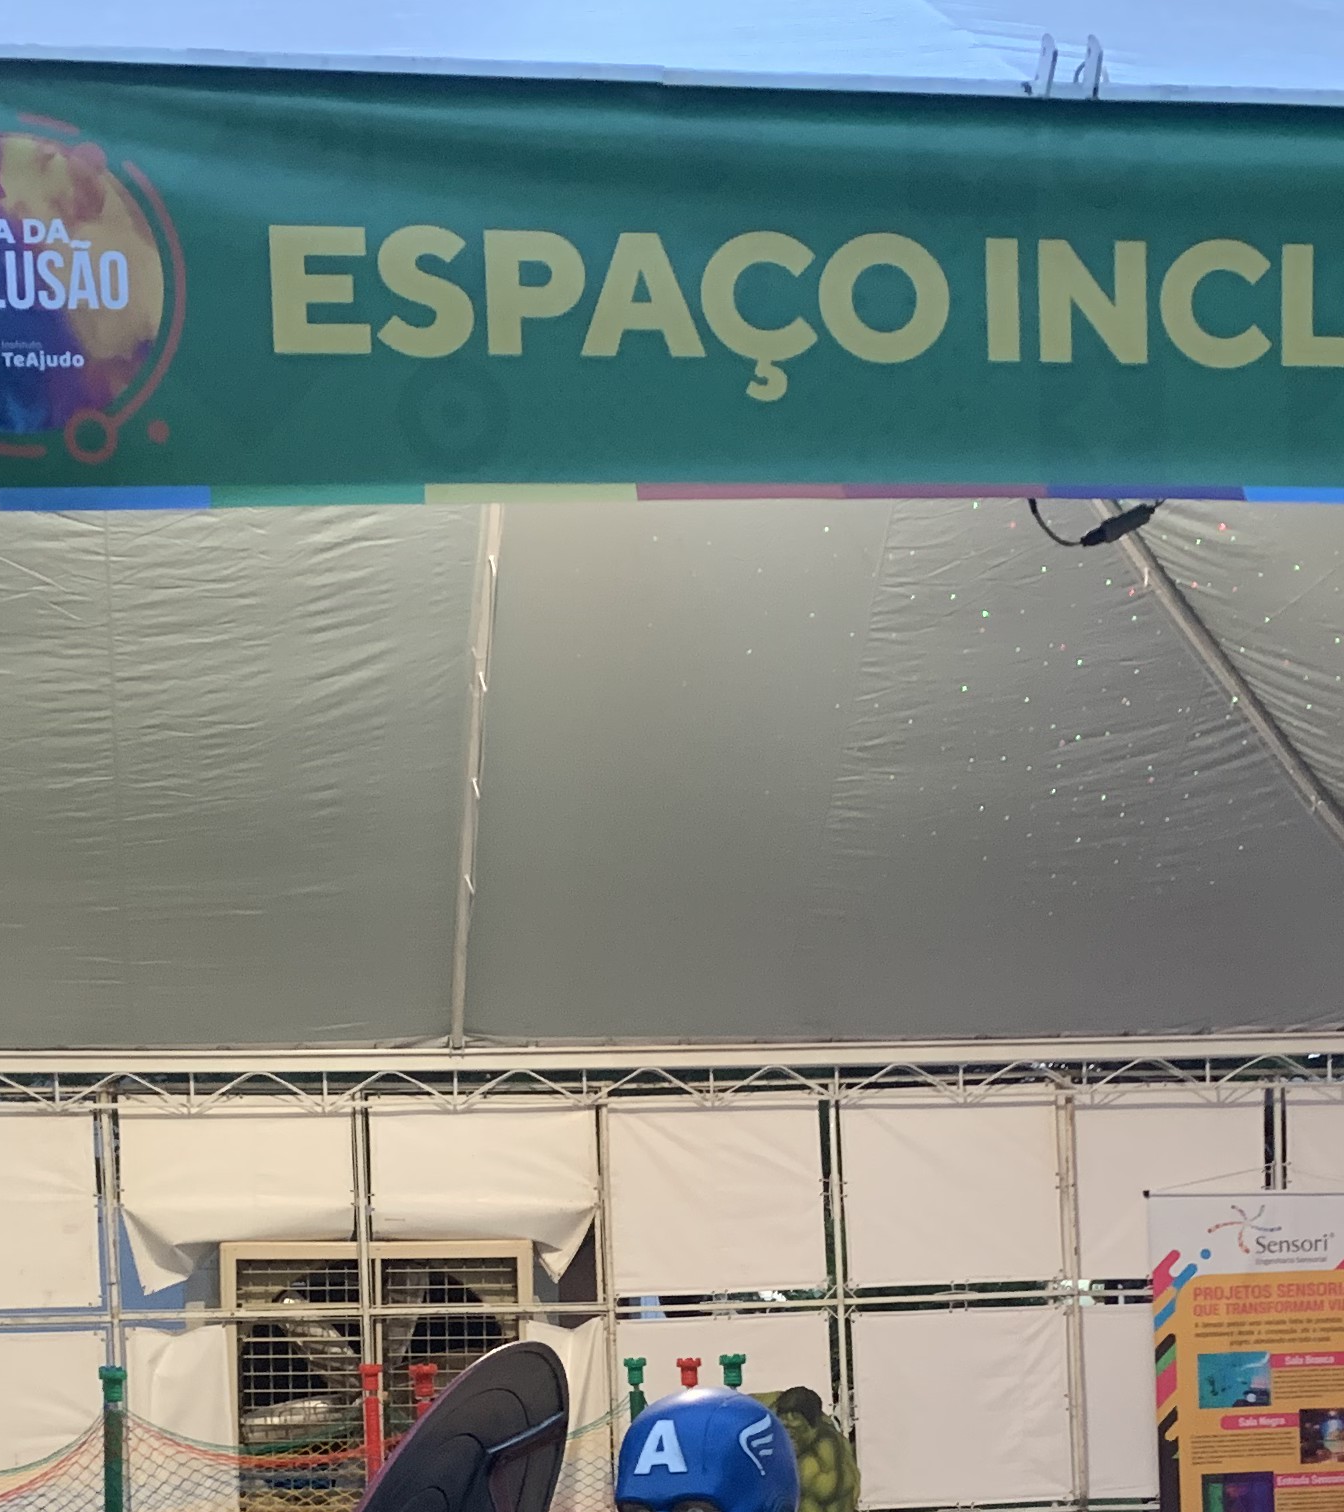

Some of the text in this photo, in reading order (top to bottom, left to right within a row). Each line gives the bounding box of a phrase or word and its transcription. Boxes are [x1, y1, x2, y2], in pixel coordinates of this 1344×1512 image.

[22, 218, 69, 244] DA
[267, 224, 950, 402] ESPAÇO
[1, 350, 84, 371] TeAjudo
[1193, 1284, 1272, 1300] PROJETOS
[1193, 1304, 1220, 1317] QUE
[1225, 1301, 1324, 1315] TRANSFORMAM
[633, 1419, 688, 1475] A
